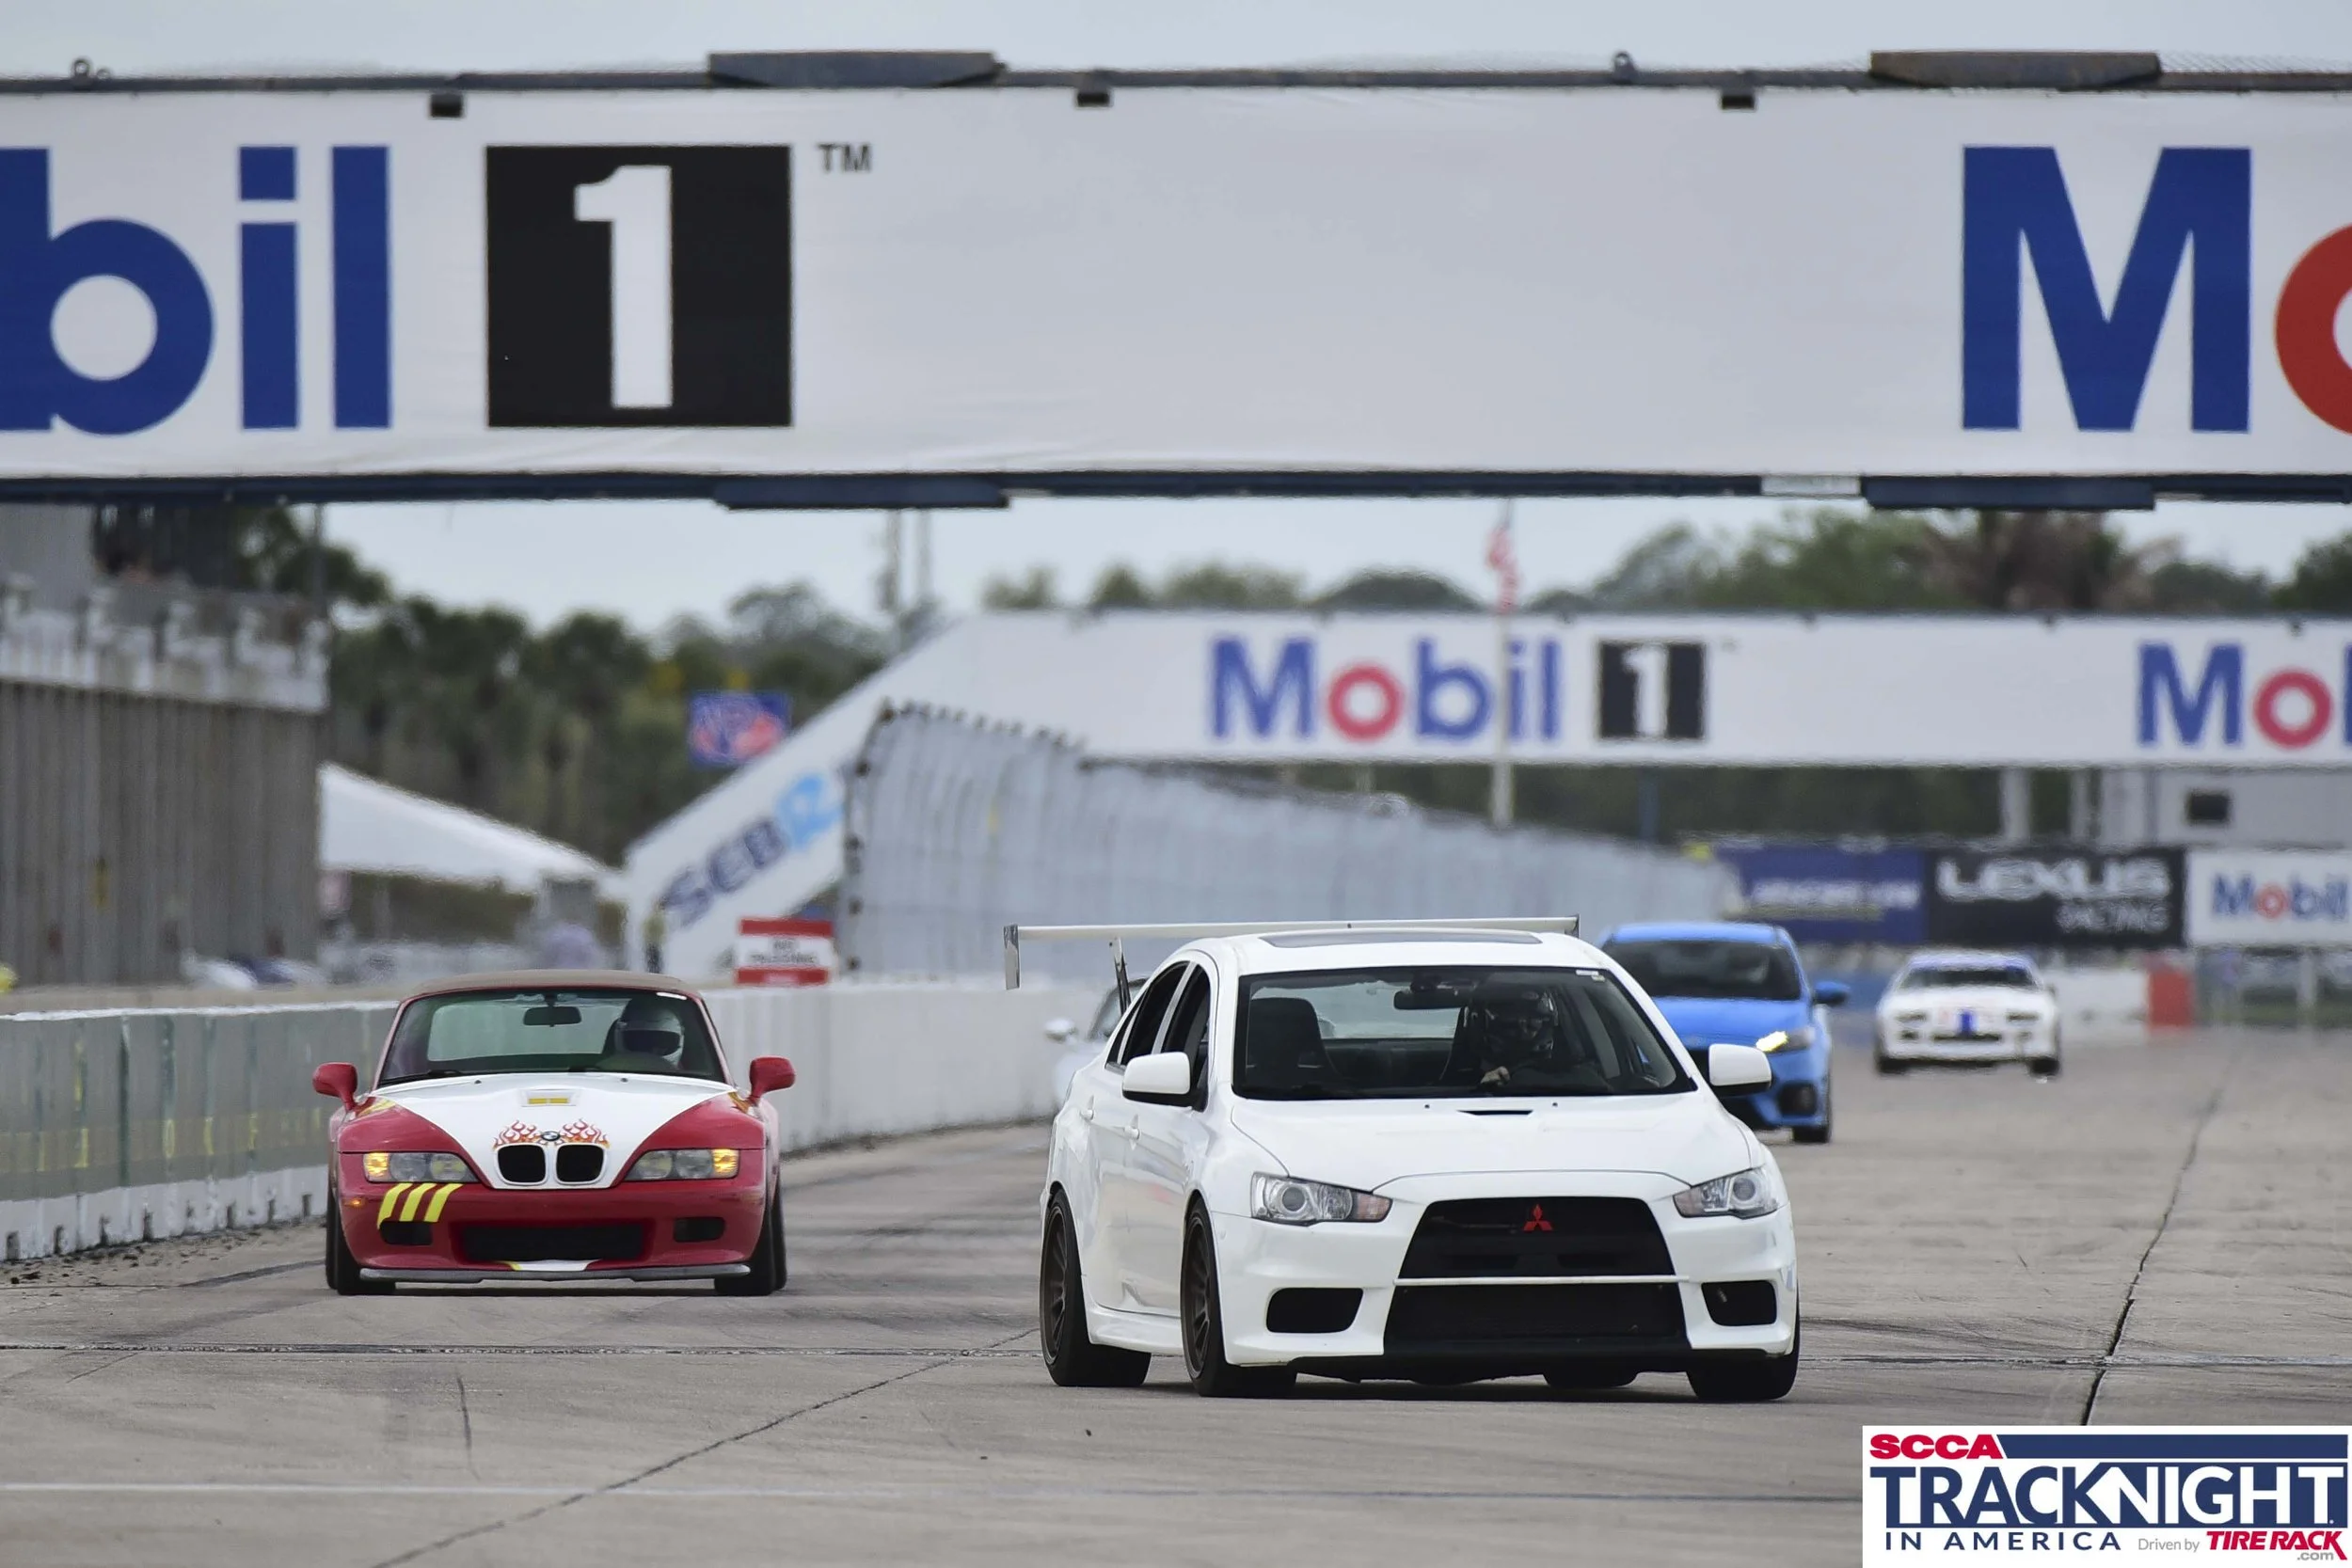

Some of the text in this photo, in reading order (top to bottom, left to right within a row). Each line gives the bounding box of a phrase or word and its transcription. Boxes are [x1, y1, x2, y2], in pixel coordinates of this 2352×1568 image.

[574, 164, 674, 409] 1
[817, 143, 872, 173] TM
[1212, 638, 1562, 742] Mobil
[2138, 641, 2352, 750] Mo
[1936, 856, 2170, 901] LEXUS
[2213, 873, 2348, 921] Mobil
